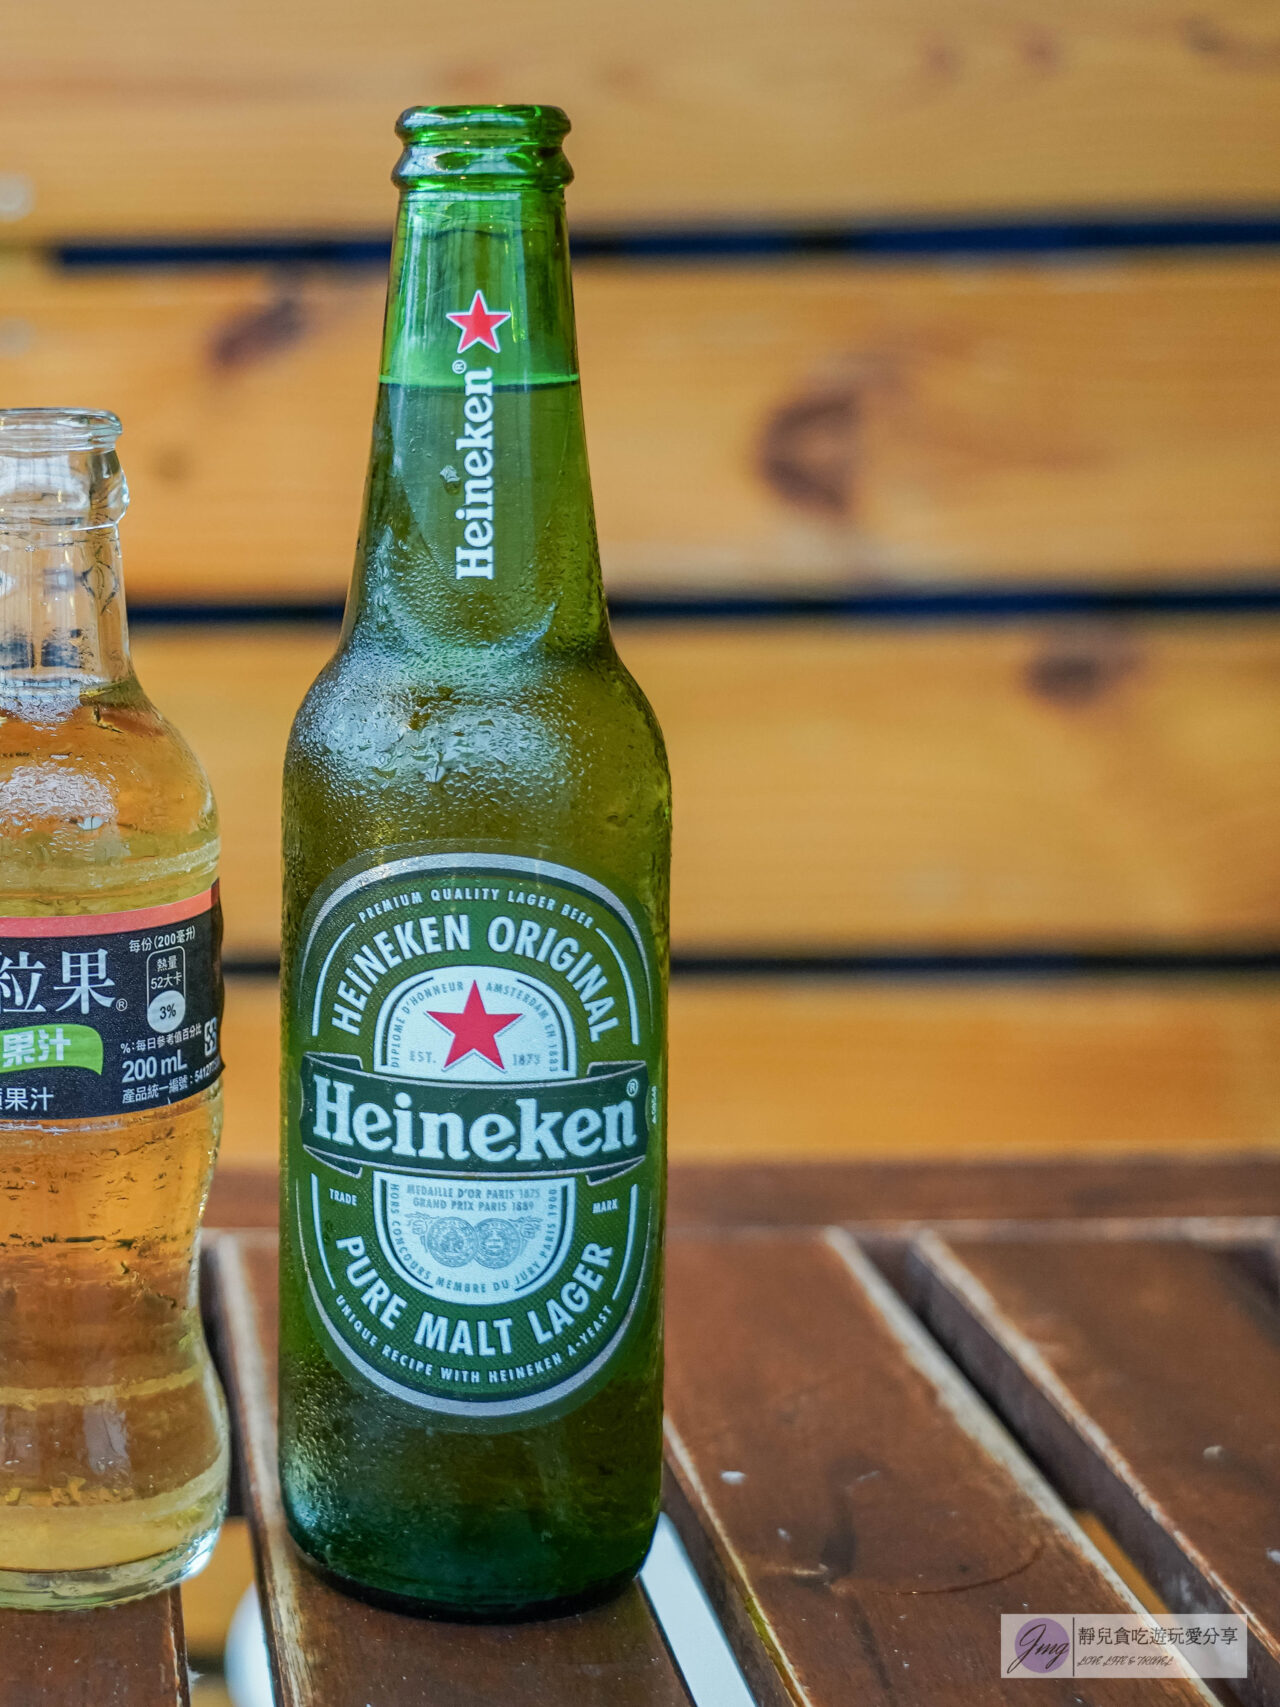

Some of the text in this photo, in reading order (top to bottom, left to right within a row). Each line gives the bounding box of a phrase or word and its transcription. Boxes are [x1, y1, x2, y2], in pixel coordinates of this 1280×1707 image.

[455, 366, 494, 580] Heineken
[358, 887, 594, 929] PREMIUM QUALITY LAGER BEER
[150, 970, 183, 990] 52大卡
[331, 914, 620, 1044] HEINEKEN ORIGINAL
[159, 1003, 177, 1020] 3%
[485, 982, 549, 1020] AMSTERDAM
[390, 981, 464, 1068] DIPLOME D'HONNEUR
[122, 1048, 188, 1083] 200 mL
[409, 1050, 437, 1064] EST.
[312, 1073, 638, 1162] Heineken
[328, 1187, 358, 1207] TRADE
[389, 1183, 400, 1214] HORS
[406, 1183, 454, 1199] MEDAILLE
[457, 1188, 482, 1199] D'OR
[486, 1188, 515, 1200] PARIS
[412, 1197, 447, 1209] GRAND
[451, 1200, 474, 1211] PRIX
[478, 1200, 507, 1212] PARIS
[592, 1198, 619, 1215] MARK
[391, 1220, 432, 1280] CONCOURS
[540, 1222, 556, 1258] PARIS
[435, 1276, 487, 1293] MEMBRE
[493, 1279, 509, 1292] DU
[514, 1260, 541, 1284] JURY
[335, 1235, 615, 1357] PURE MALT LAGER
[335, 1294, 614, 1383] UNIQUE RECIPE WITH HEINEKEN A-YEAST
